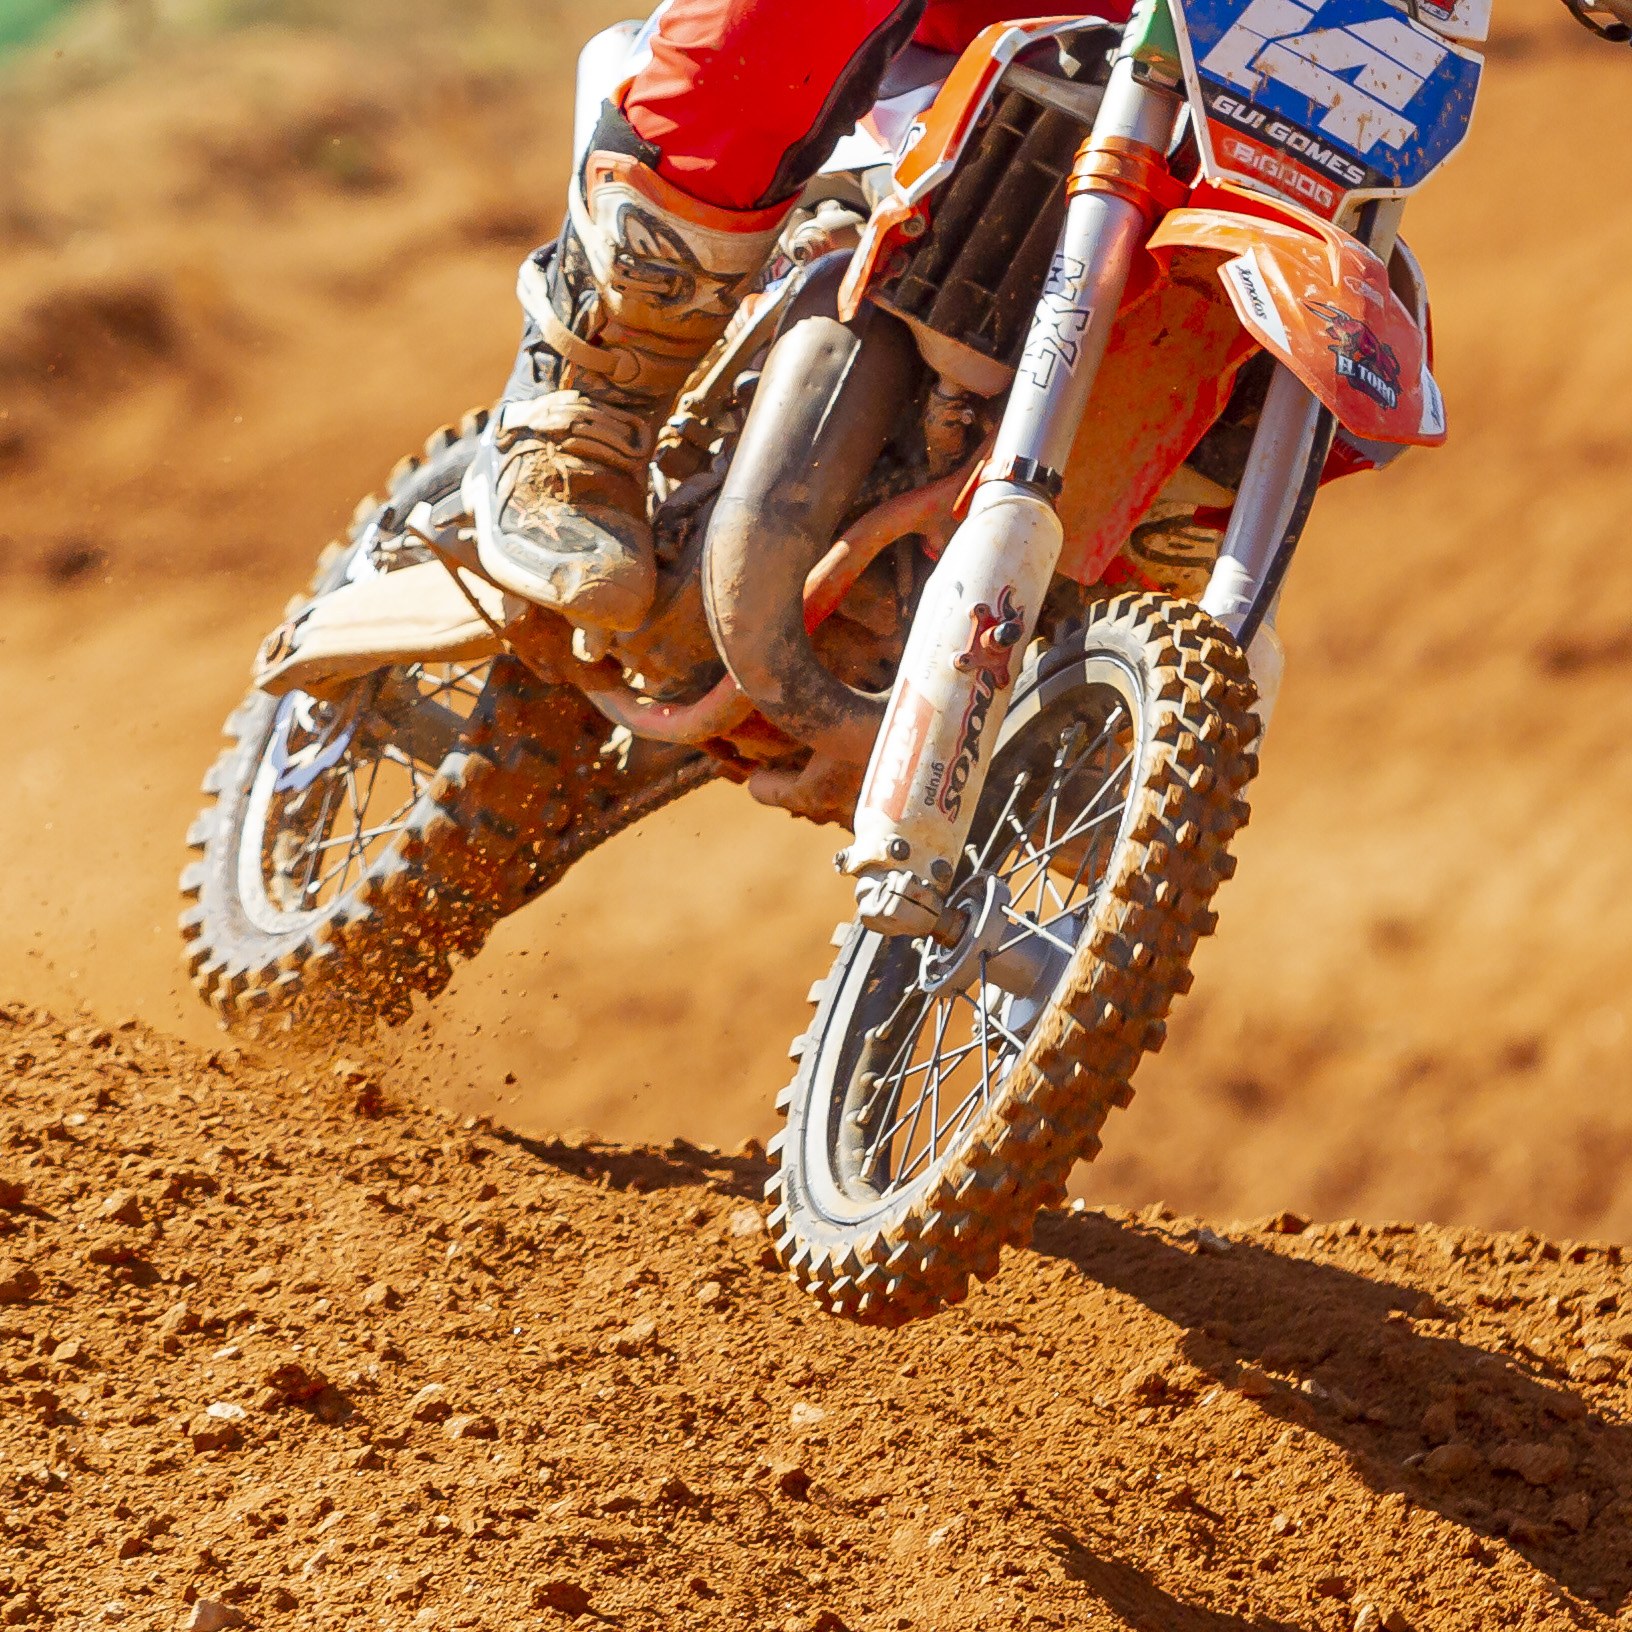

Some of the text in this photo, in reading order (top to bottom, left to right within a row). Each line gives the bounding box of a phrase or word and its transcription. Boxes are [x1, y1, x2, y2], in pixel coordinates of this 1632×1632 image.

[1211, 94, 1366, 185] GUI GOMES
[1337, 355, 1357, 379] EL
[1357, 364, 1397, 409] TORO
[923, 759, 945, 808] grupo
